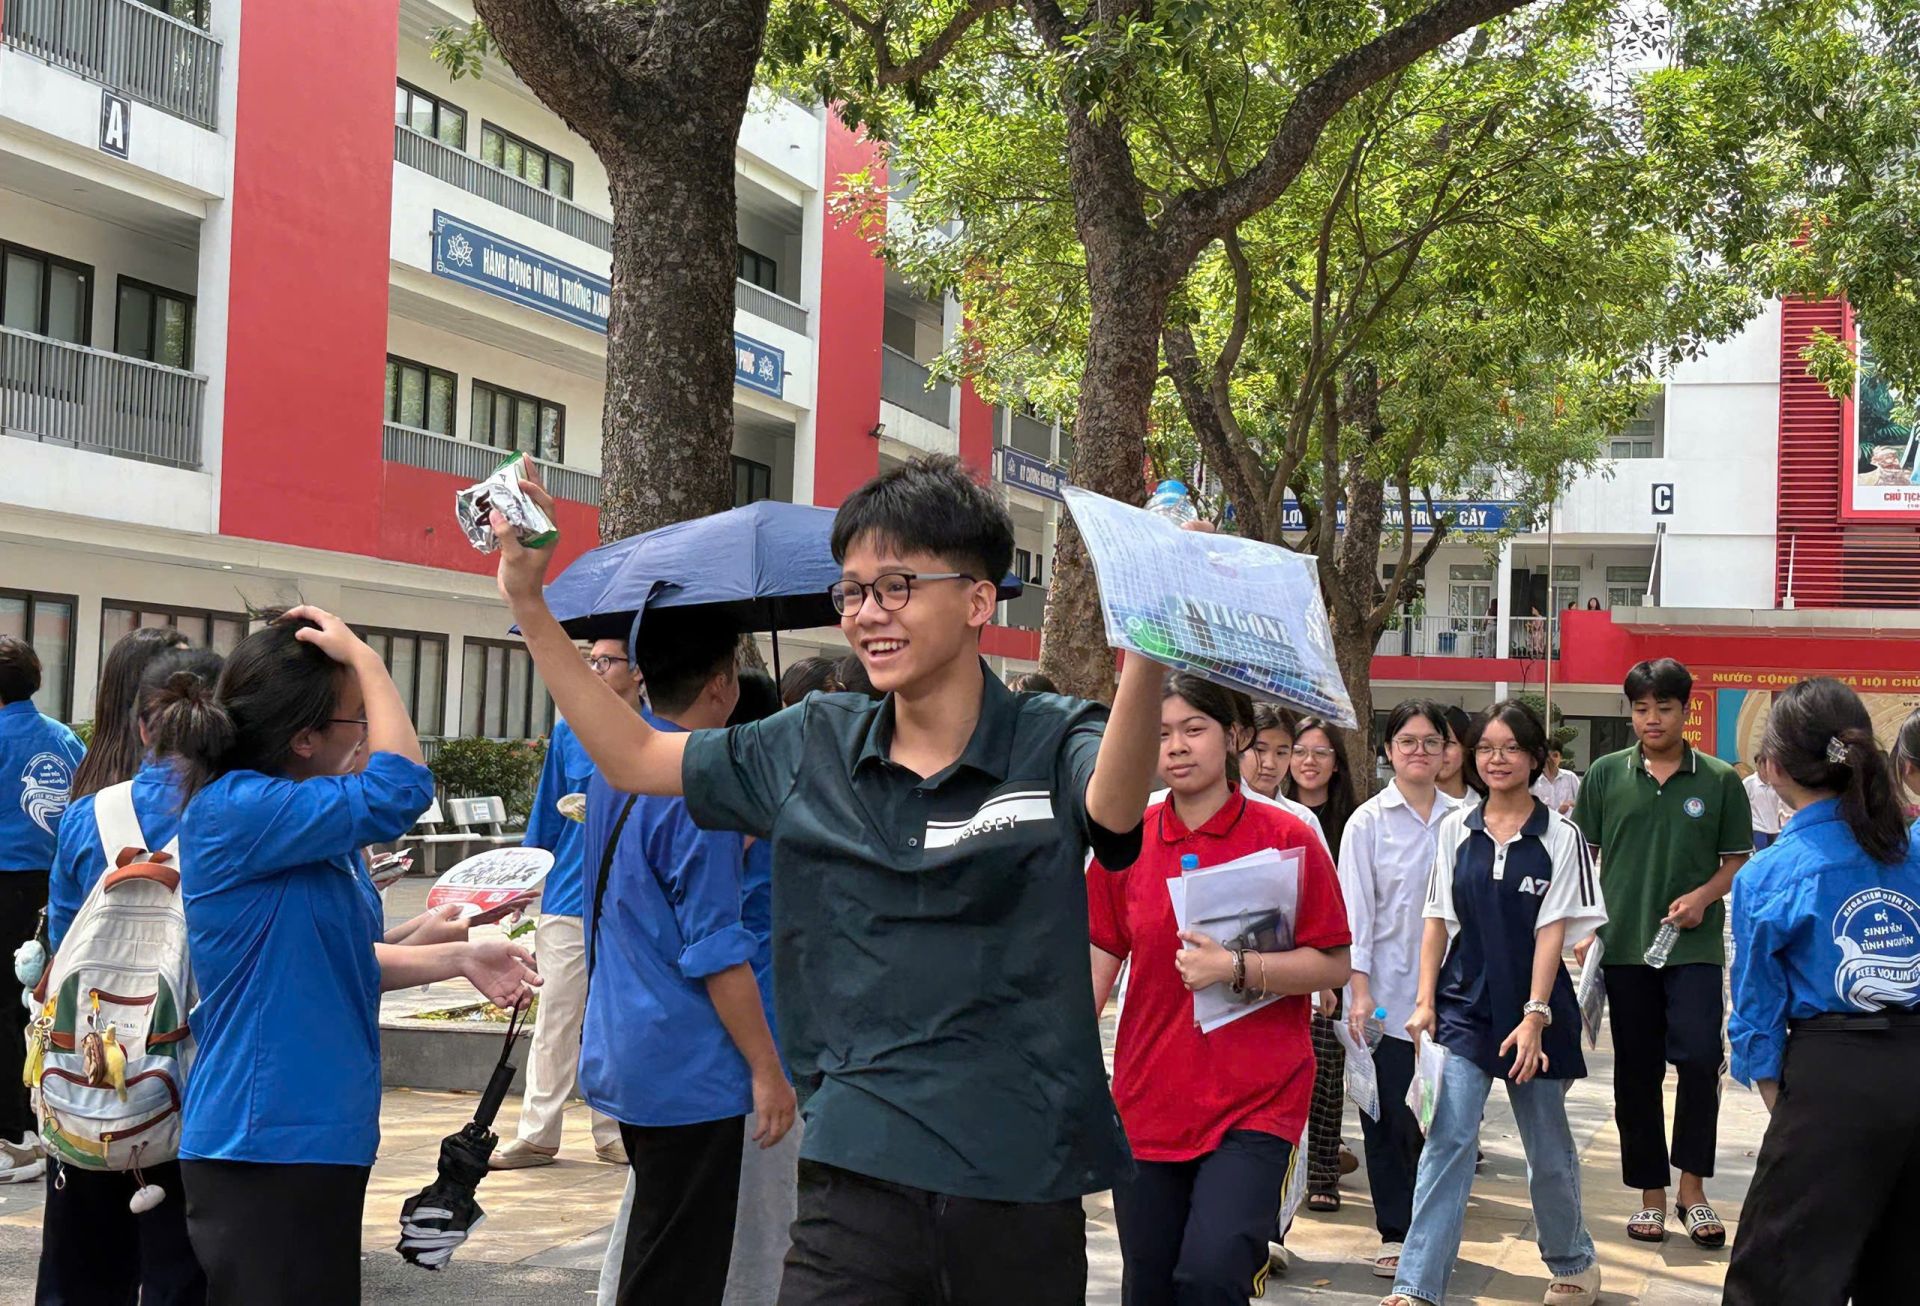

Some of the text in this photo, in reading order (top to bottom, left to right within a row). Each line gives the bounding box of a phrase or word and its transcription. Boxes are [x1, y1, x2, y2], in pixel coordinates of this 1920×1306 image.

[105, 100, 124, 149] A
[483, 244, 507, 281] HÀNH
[533, 263, 542, 294] VÌ
[543, 270, 560, 301] NHÀ
[592, 290, 611, 319] XAN
[1655, 485, 1671, 511] C
[1883, 488, 1901, 502] CHỦ
[1459, 508, 1487, 526] CÂY
[1712, 671, 1753, 684] NƯỚC
[1862, 676, 1887, 688] HỘI
[1518, 875, 1551, 897] A7
[1863, 925, 1889, 937] SINH
[1861, 939, 1885, 951] TÌNH
